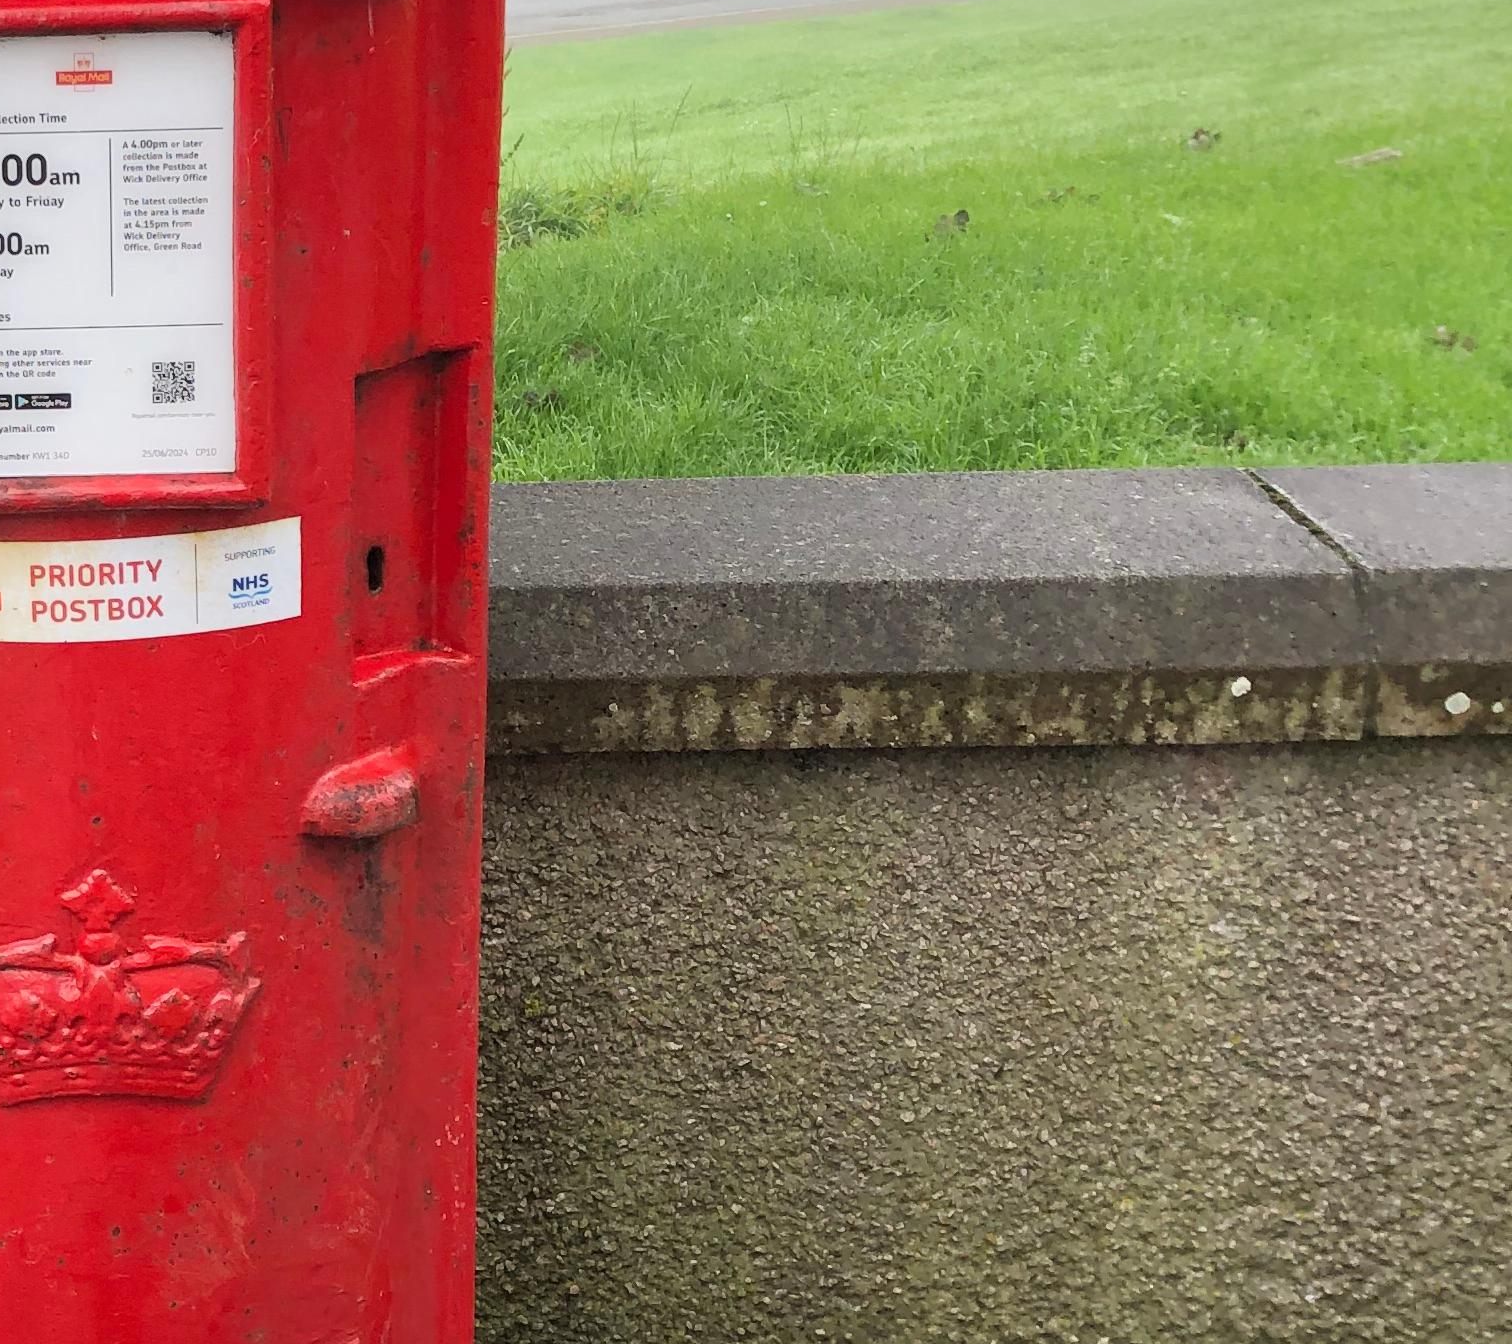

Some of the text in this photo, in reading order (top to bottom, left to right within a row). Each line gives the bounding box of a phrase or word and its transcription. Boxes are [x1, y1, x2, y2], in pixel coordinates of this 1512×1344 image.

[58, 72, 110, 85] Royal Mail
[39, 113, 68, 124] Time
[130, 139, 168, 151] 4.00pm
[182, 139, 203, 148] later
[122, 151, 199, 161] collection is made
[122, 163, 143, 172] from
[146, 163, 160, 171] the
[162, 162, 196, 172] Postbox
[122, 173, 208, 184] Wick Delivery Office
[9, 196, 21, 208] to
[26, 195, 65, 209] Friday
[123, 196, 209, 206] The latest collection
[123, 209, 131, 217] in
[134, 208, 148, 217] the
[171, 208, 179, 216] is
[181, 207, 205, 215] made
[123, 221, 132, 229] at
[171, 220, 192, 228] from
[123, 232, 181, 241] Wick Delivery
[153, 242, 179, 251] Green
[181, 242, 202, 250] Road
[6, 348, 20, 356] the
[22, 350, 38, 358] app
[12, 359, 34, 367] other
[37, 359, 70, 367] services
[6, 370, 20, 378] the
[22, 370, 35, 378] QR
[37, 370, 56, 378] code
[224, 546, 276, 562] SUPPORTING
[29, 558, 163, 588] PRIORITY
[232, 573, 269, 592] NHS
[31, 594, 164, 623] POSTBOX
[232, 597, 270, 610] SCOTLAND
